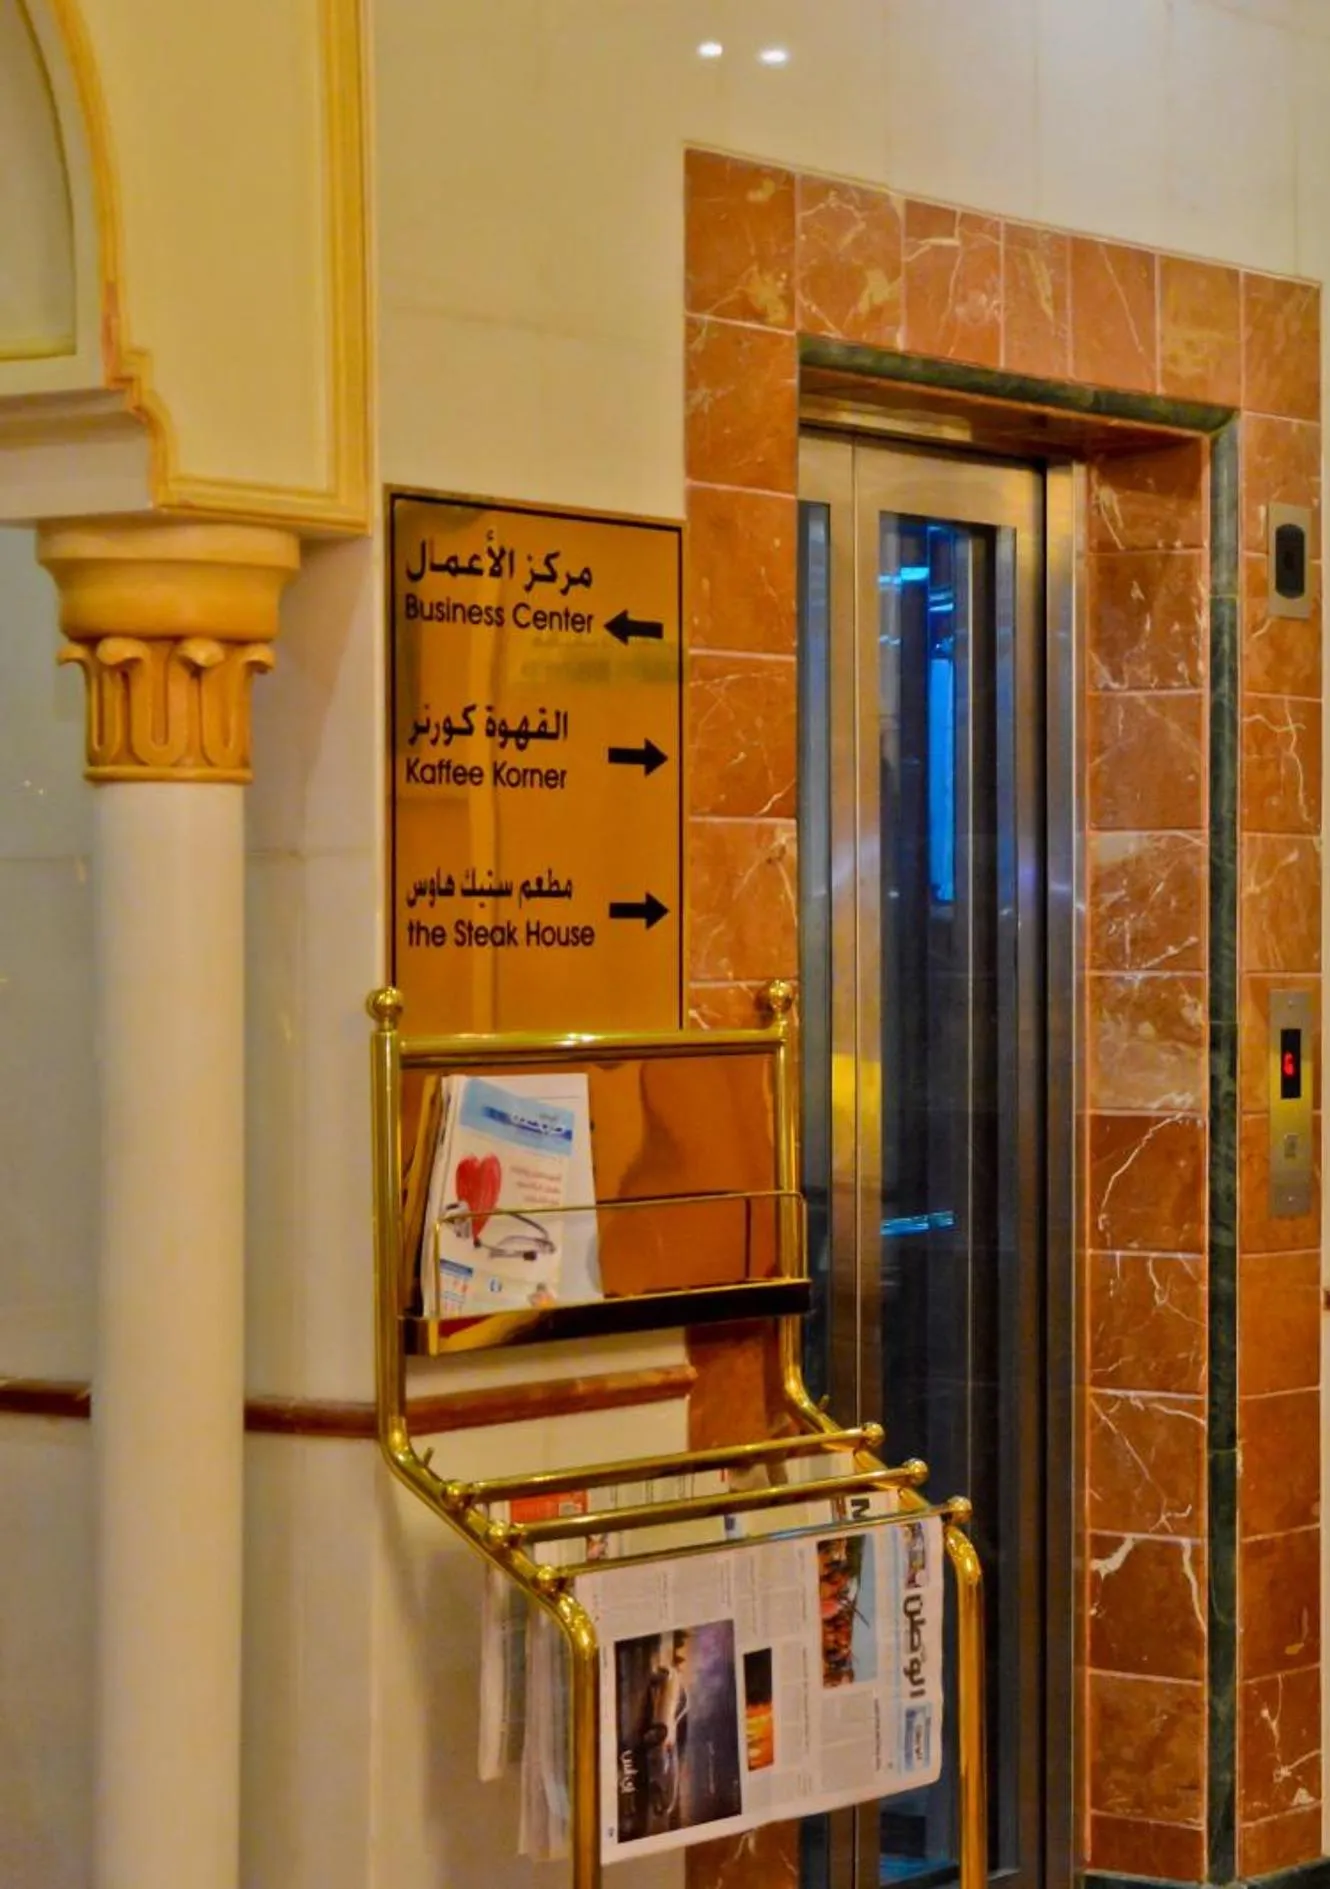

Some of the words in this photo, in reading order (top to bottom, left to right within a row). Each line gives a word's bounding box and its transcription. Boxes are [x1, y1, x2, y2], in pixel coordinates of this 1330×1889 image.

[405, 530, 514, 582] الأعمال
[524, 551, 592, 596] مركز
[405, 594, 504, 627] Business
[512, 602, 594, 633] Center
[408, 704, 476, 746] كورنر
[486, 705, 568, 751] القهوة
[406, 757, 484, 786] Kaffee
[493, 760, 567, 789] Korner
[407, 867, 455, 908] هاوس
[518, 868, 573, 909] مطعم
[407, 919, 446, 947] the
[454, 919, 518, 947] Steak
[526, 920, 595, 947] House
